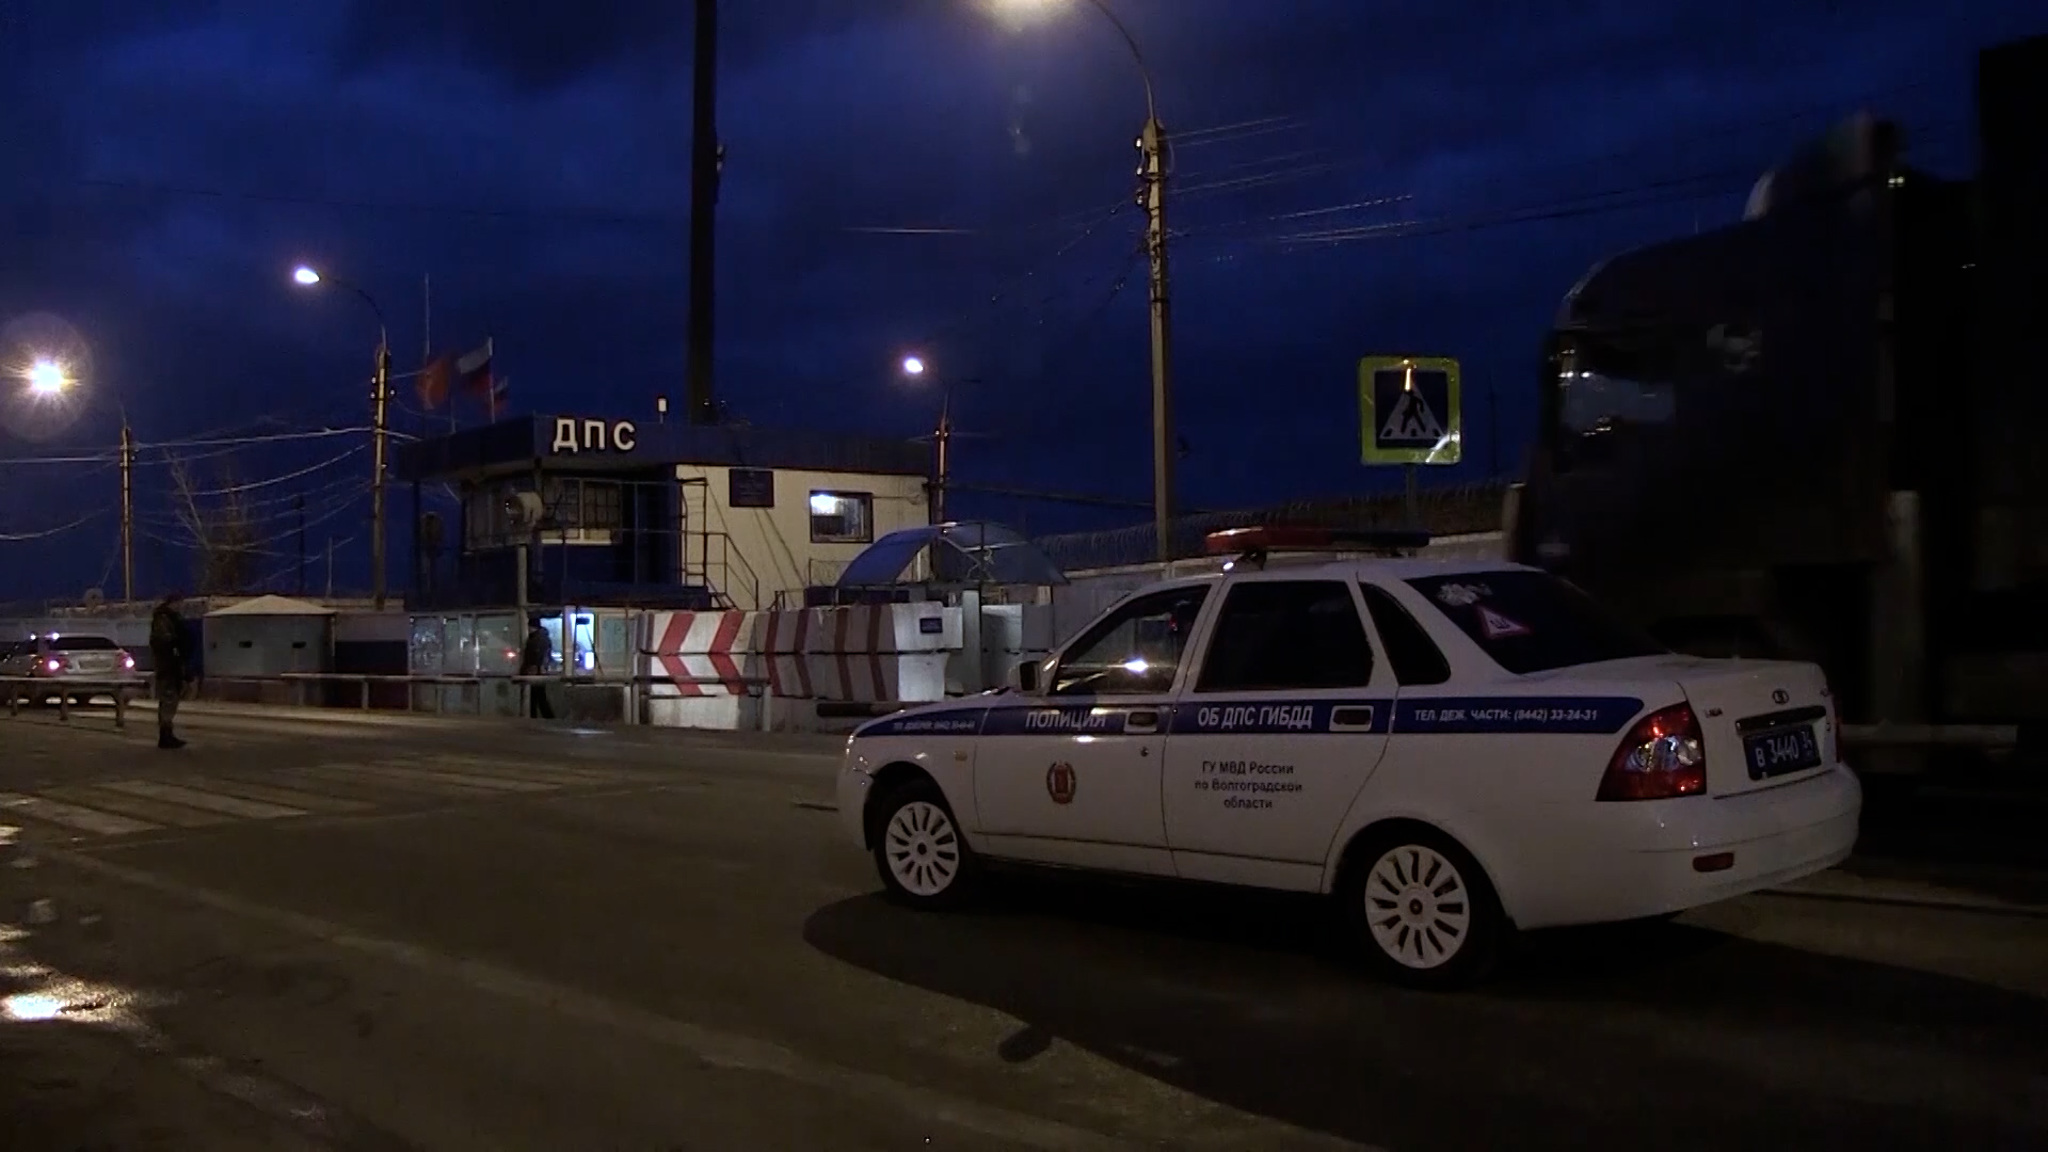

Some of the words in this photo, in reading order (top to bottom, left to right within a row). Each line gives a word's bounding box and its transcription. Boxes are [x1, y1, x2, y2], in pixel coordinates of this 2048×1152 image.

[552, 417, 636, 454] ДПС
[1025, 709, 1107, 730] ПОЛИЦИЯ
[1197, 706, 1220, 727] ОБ
[1221, 706, 1257, 730] ДПС
[1258, 704, 1314, 729] ГИБДД
[1202, 761, 1216, 773] ГУ
[1219, 761, 1246, 775] МВД
[1249, 761, 1294, 774] России
[1195, 780, 1209, 789] по
[1212, 779, 1303, 793] Волгоградской
[1224, 795, 1273, 808] области
